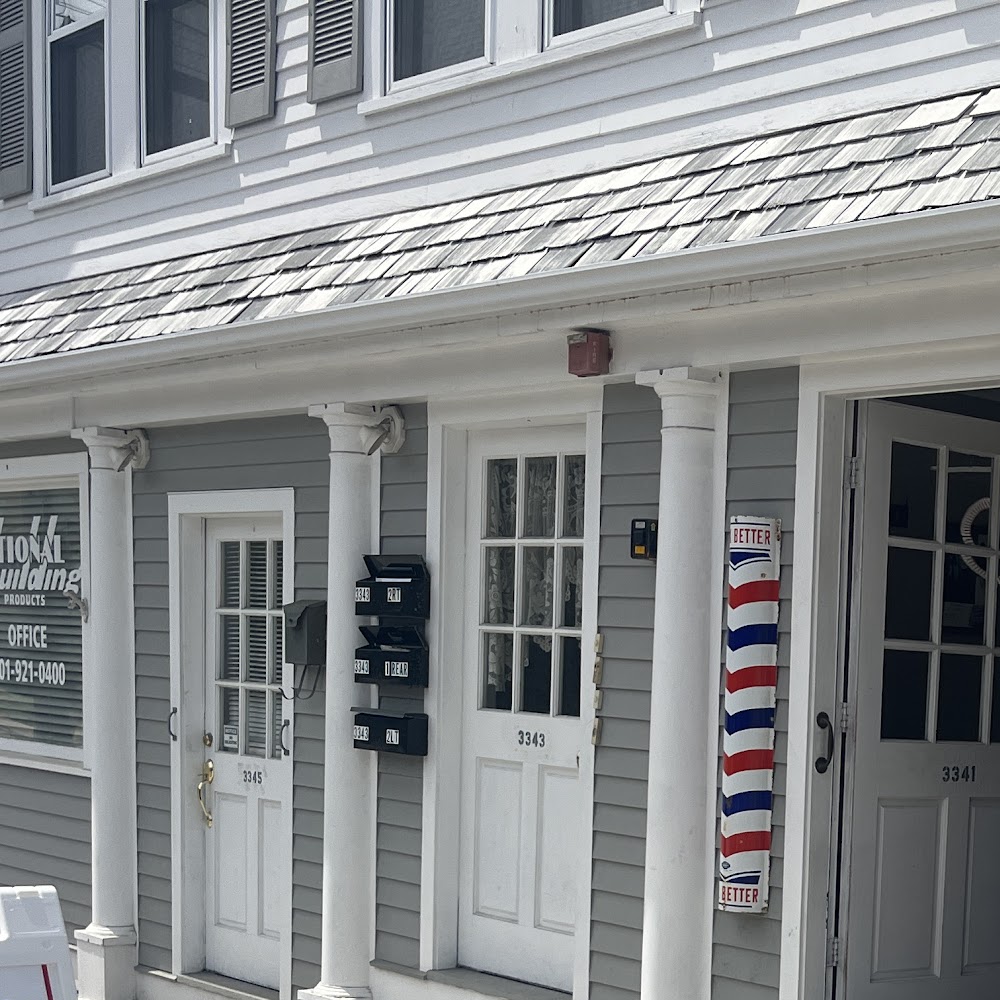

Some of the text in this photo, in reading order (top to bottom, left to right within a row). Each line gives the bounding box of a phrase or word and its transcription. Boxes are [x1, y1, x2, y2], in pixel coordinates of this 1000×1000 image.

[733, 528, 771, 546] BETTER
[4, 594, 46, 606] PRODUCTS
[355, 588, 370, 601] 3343
[8, 624, 48, 649] OFFICE
[0, 658, 66, 686] 01-921-0400
[355, 660, 369, 674] 3343
[391, 662, 408, 676] REAR
[354, 726, 369, 740] 3343
[518, 729, 545, 748] 3343
[243, 769, 263, 785] 3345
[942, 765, 976, 782] 3341
[721, 885, 759, 903] BETTER
